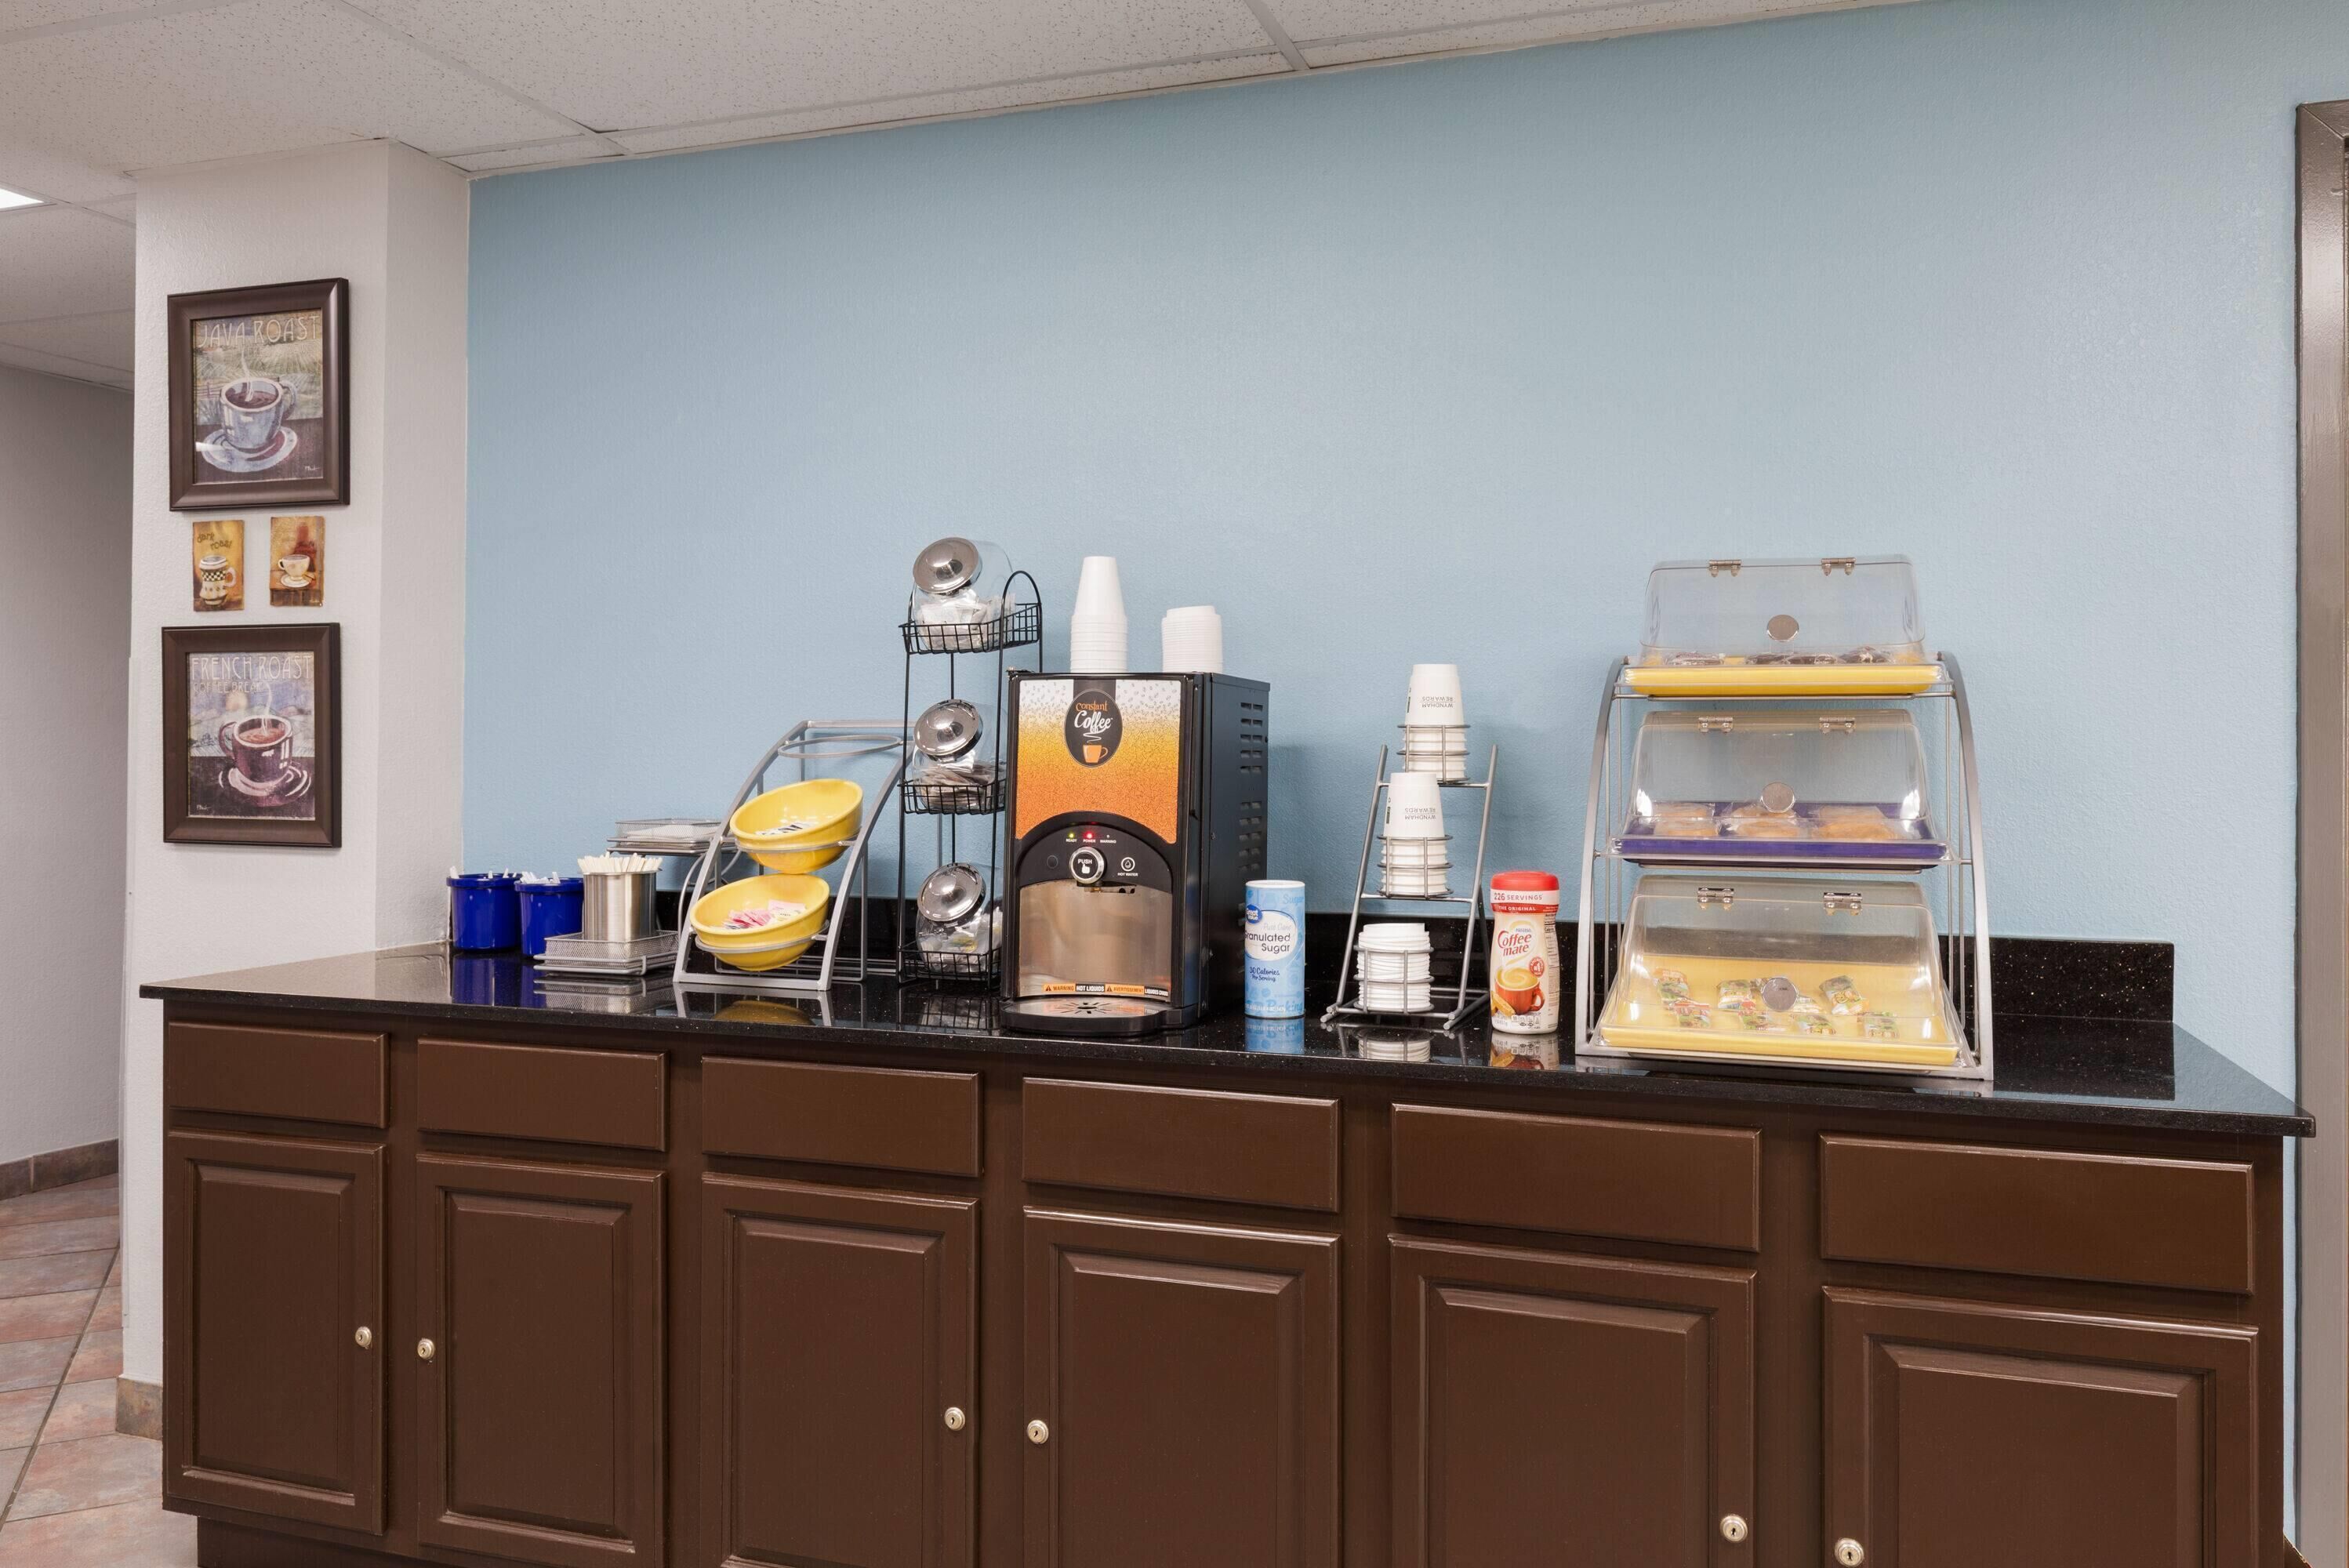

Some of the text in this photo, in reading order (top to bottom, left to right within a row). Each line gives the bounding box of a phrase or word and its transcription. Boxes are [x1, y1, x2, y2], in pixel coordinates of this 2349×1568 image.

[198, 315, 320, 347] JAVA ROAST
[198, 532, 215, 543] dark
[192, 655, 313, 681] FRENCH ROAST
[194, 681, 263, 693] COFFEE BREAK
[1075, 700, 1107, 712] constant
[1074, 710, 1111, 734] Coffee
[1498, 930, 1532, 949] Coffee
[1262, 943, 1290, 954] Sugar
[1503, 944, 1529, 956] mate
[1256, 967, 1280, 975] Calories
